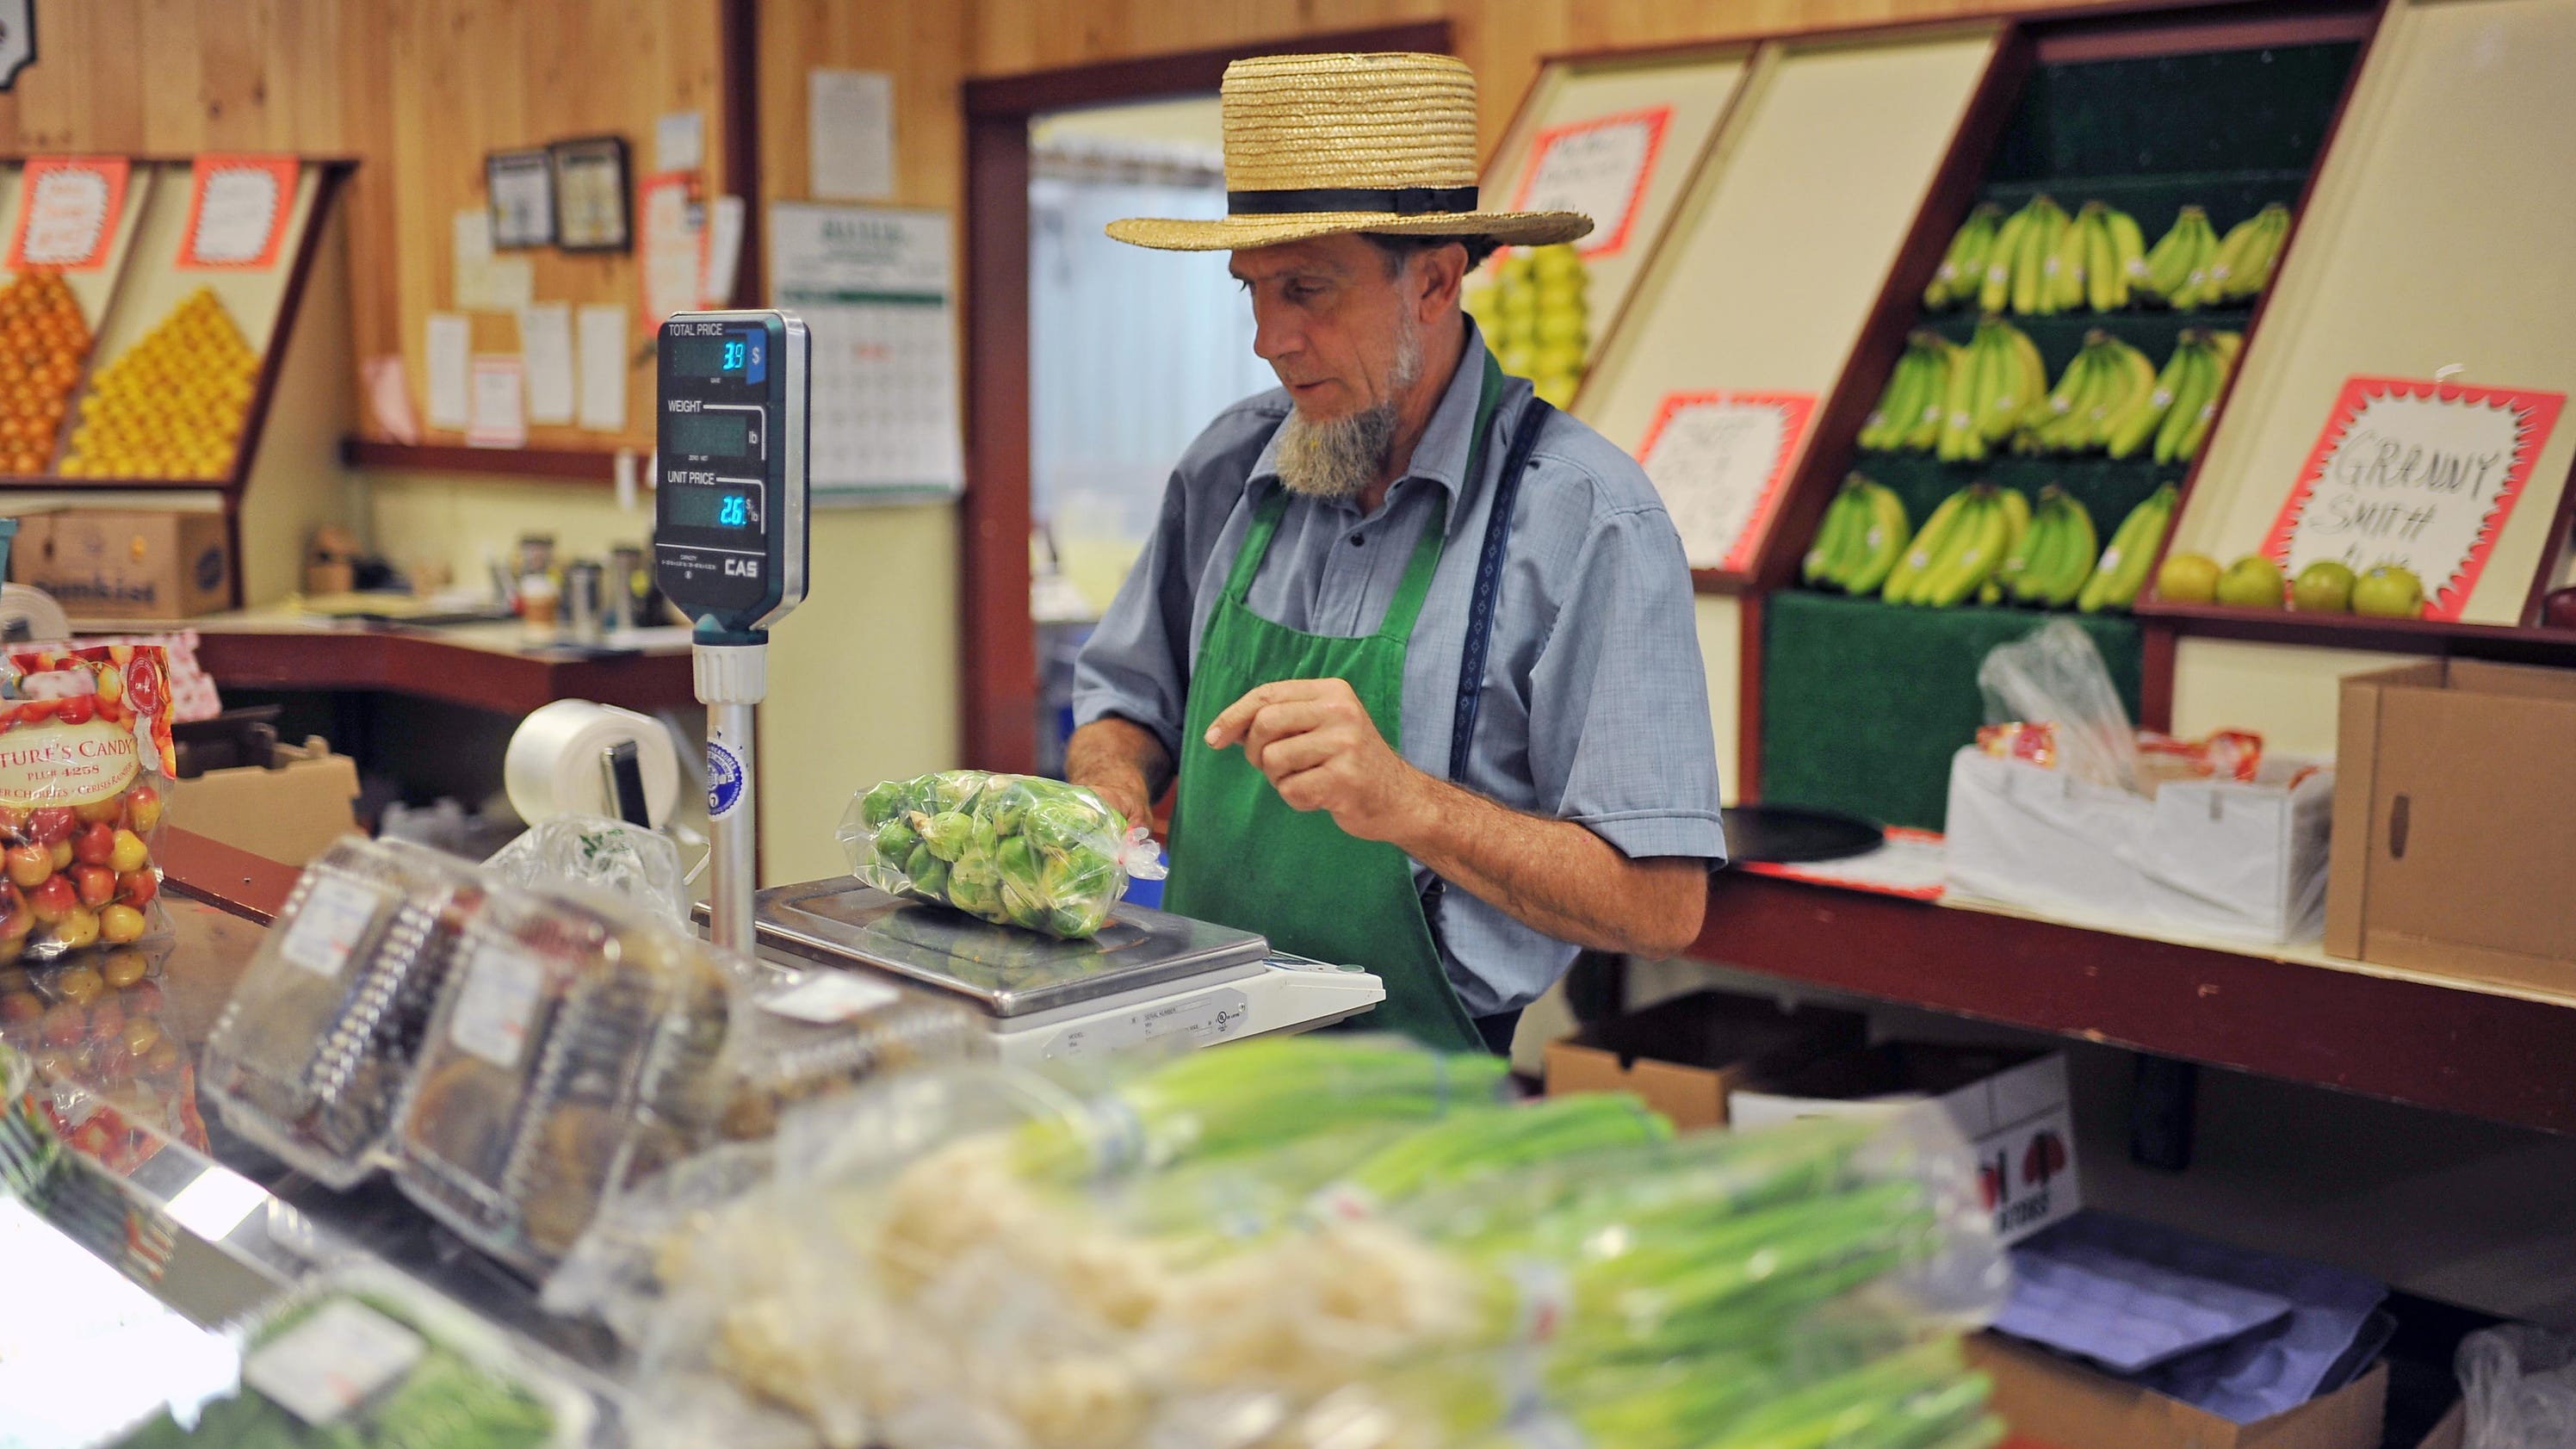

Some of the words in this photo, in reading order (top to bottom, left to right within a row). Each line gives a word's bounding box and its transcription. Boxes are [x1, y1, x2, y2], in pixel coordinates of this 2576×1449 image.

[668, 324, 696, 337] TOTAL
[697, 323, 723, 337] PRICE
[668, 399, 702, 412] WEIGHT
[748, 430, 758, 444] lb
[2335, 430, 2501, 501] GRANNY
[667, 470, 687, 483] UNIT
[689, 472, 715, 485] PRICE
[724, 558, 758, 578] CAS
[78, 738, 133, 758] CANDY
[61, 764, 100, 777] 4258
